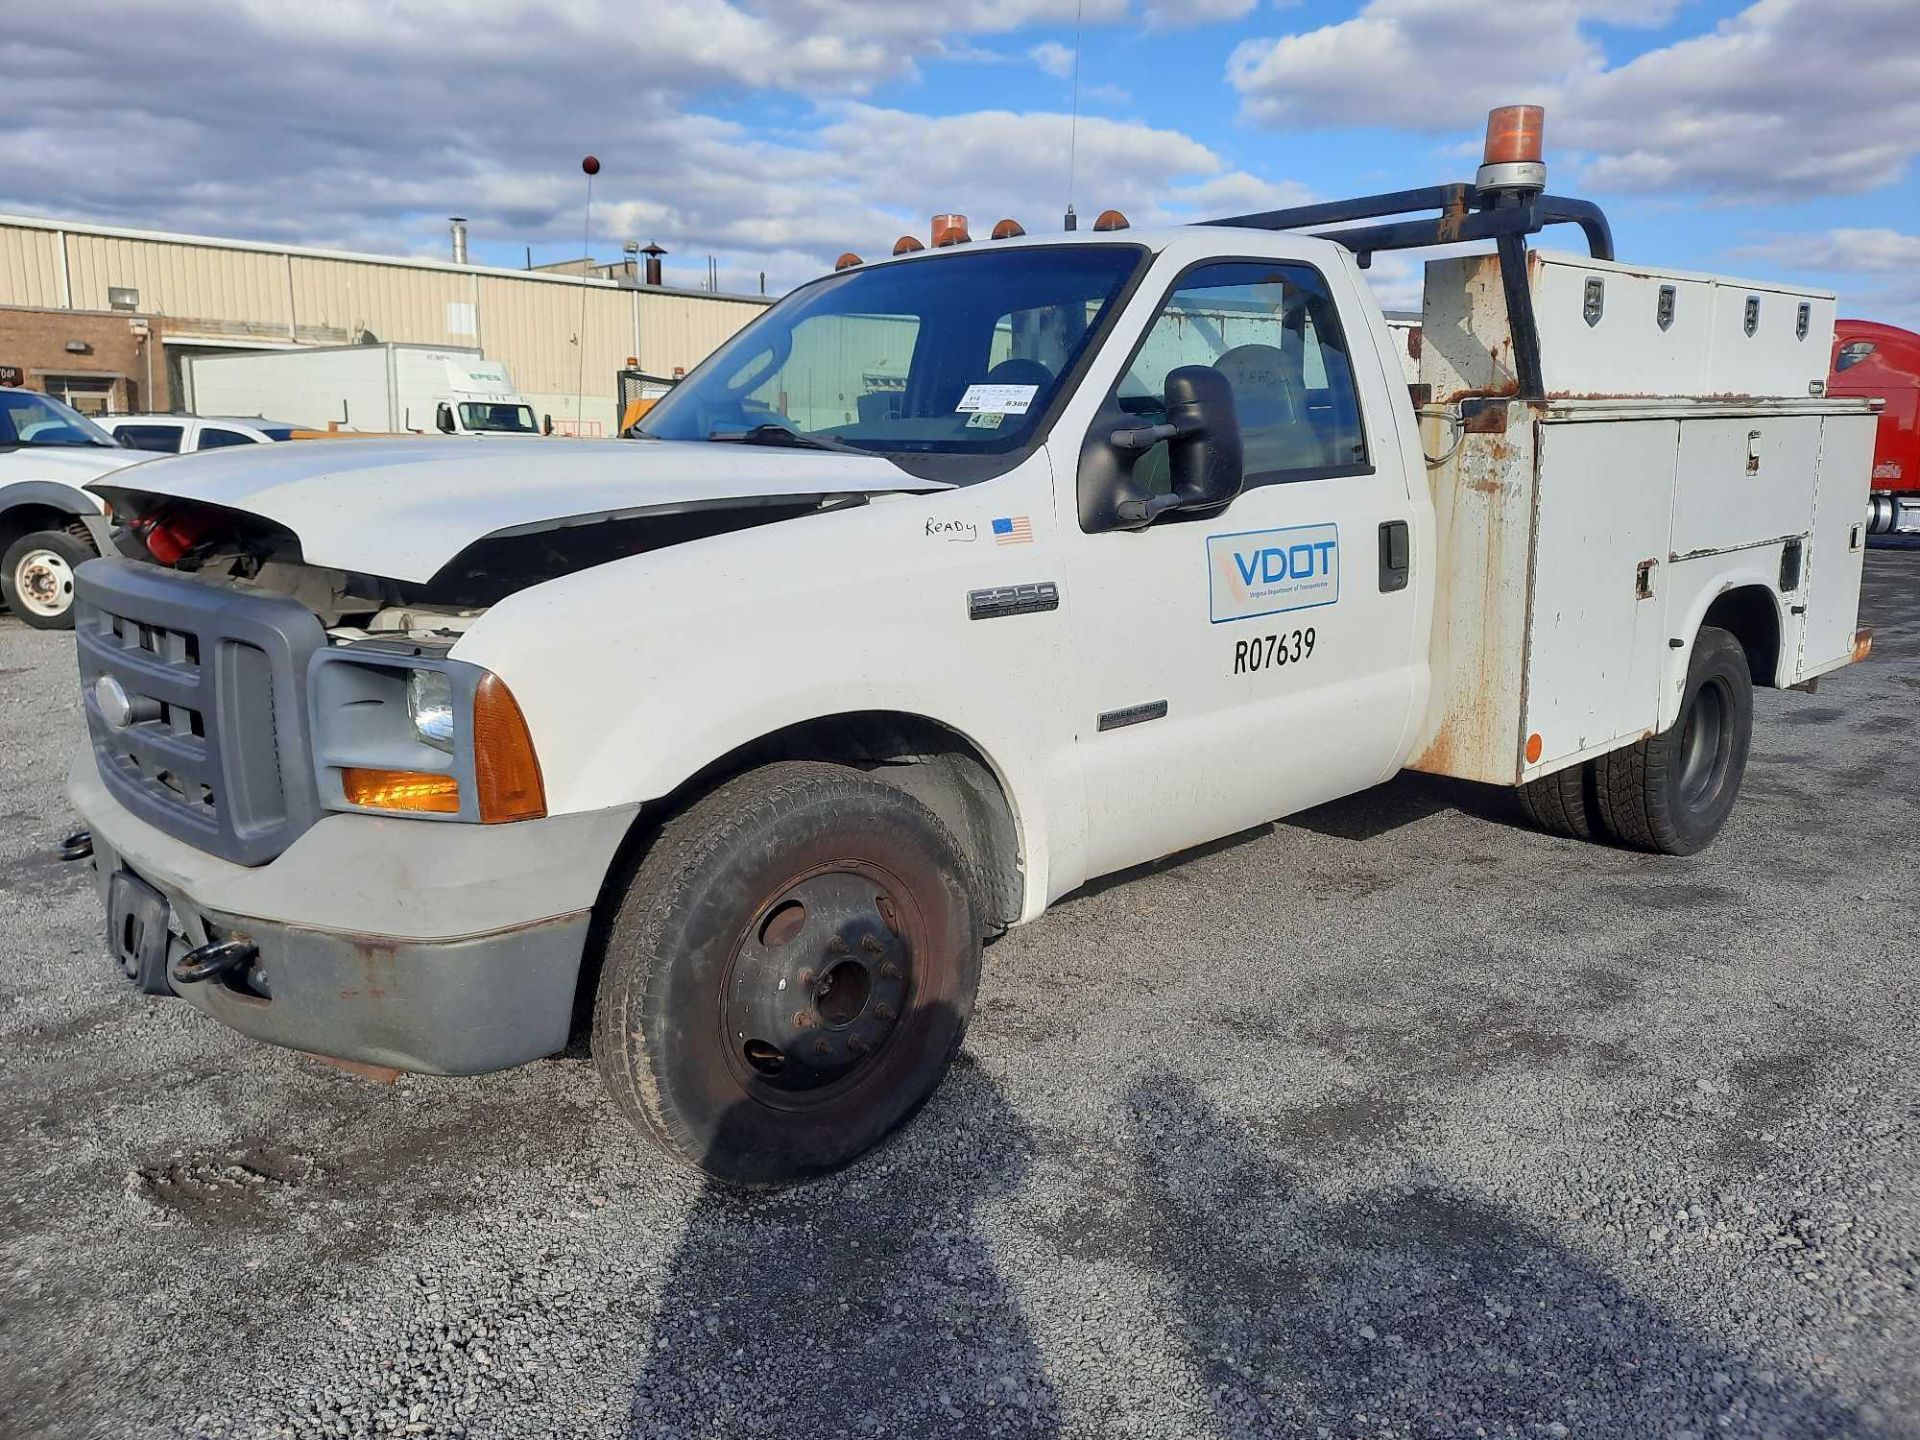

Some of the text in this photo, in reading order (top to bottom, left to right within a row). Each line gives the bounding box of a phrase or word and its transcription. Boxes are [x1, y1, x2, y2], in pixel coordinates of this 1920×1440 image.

[1233, 541, 1336, 586] VDOT
[1249, 589, 1267, 598] Virginia
[1267, 585, 1293, 596] Department
[1299, 580, 1328, 590] Transportation
[1234, 627, 1316, 675] R07639
